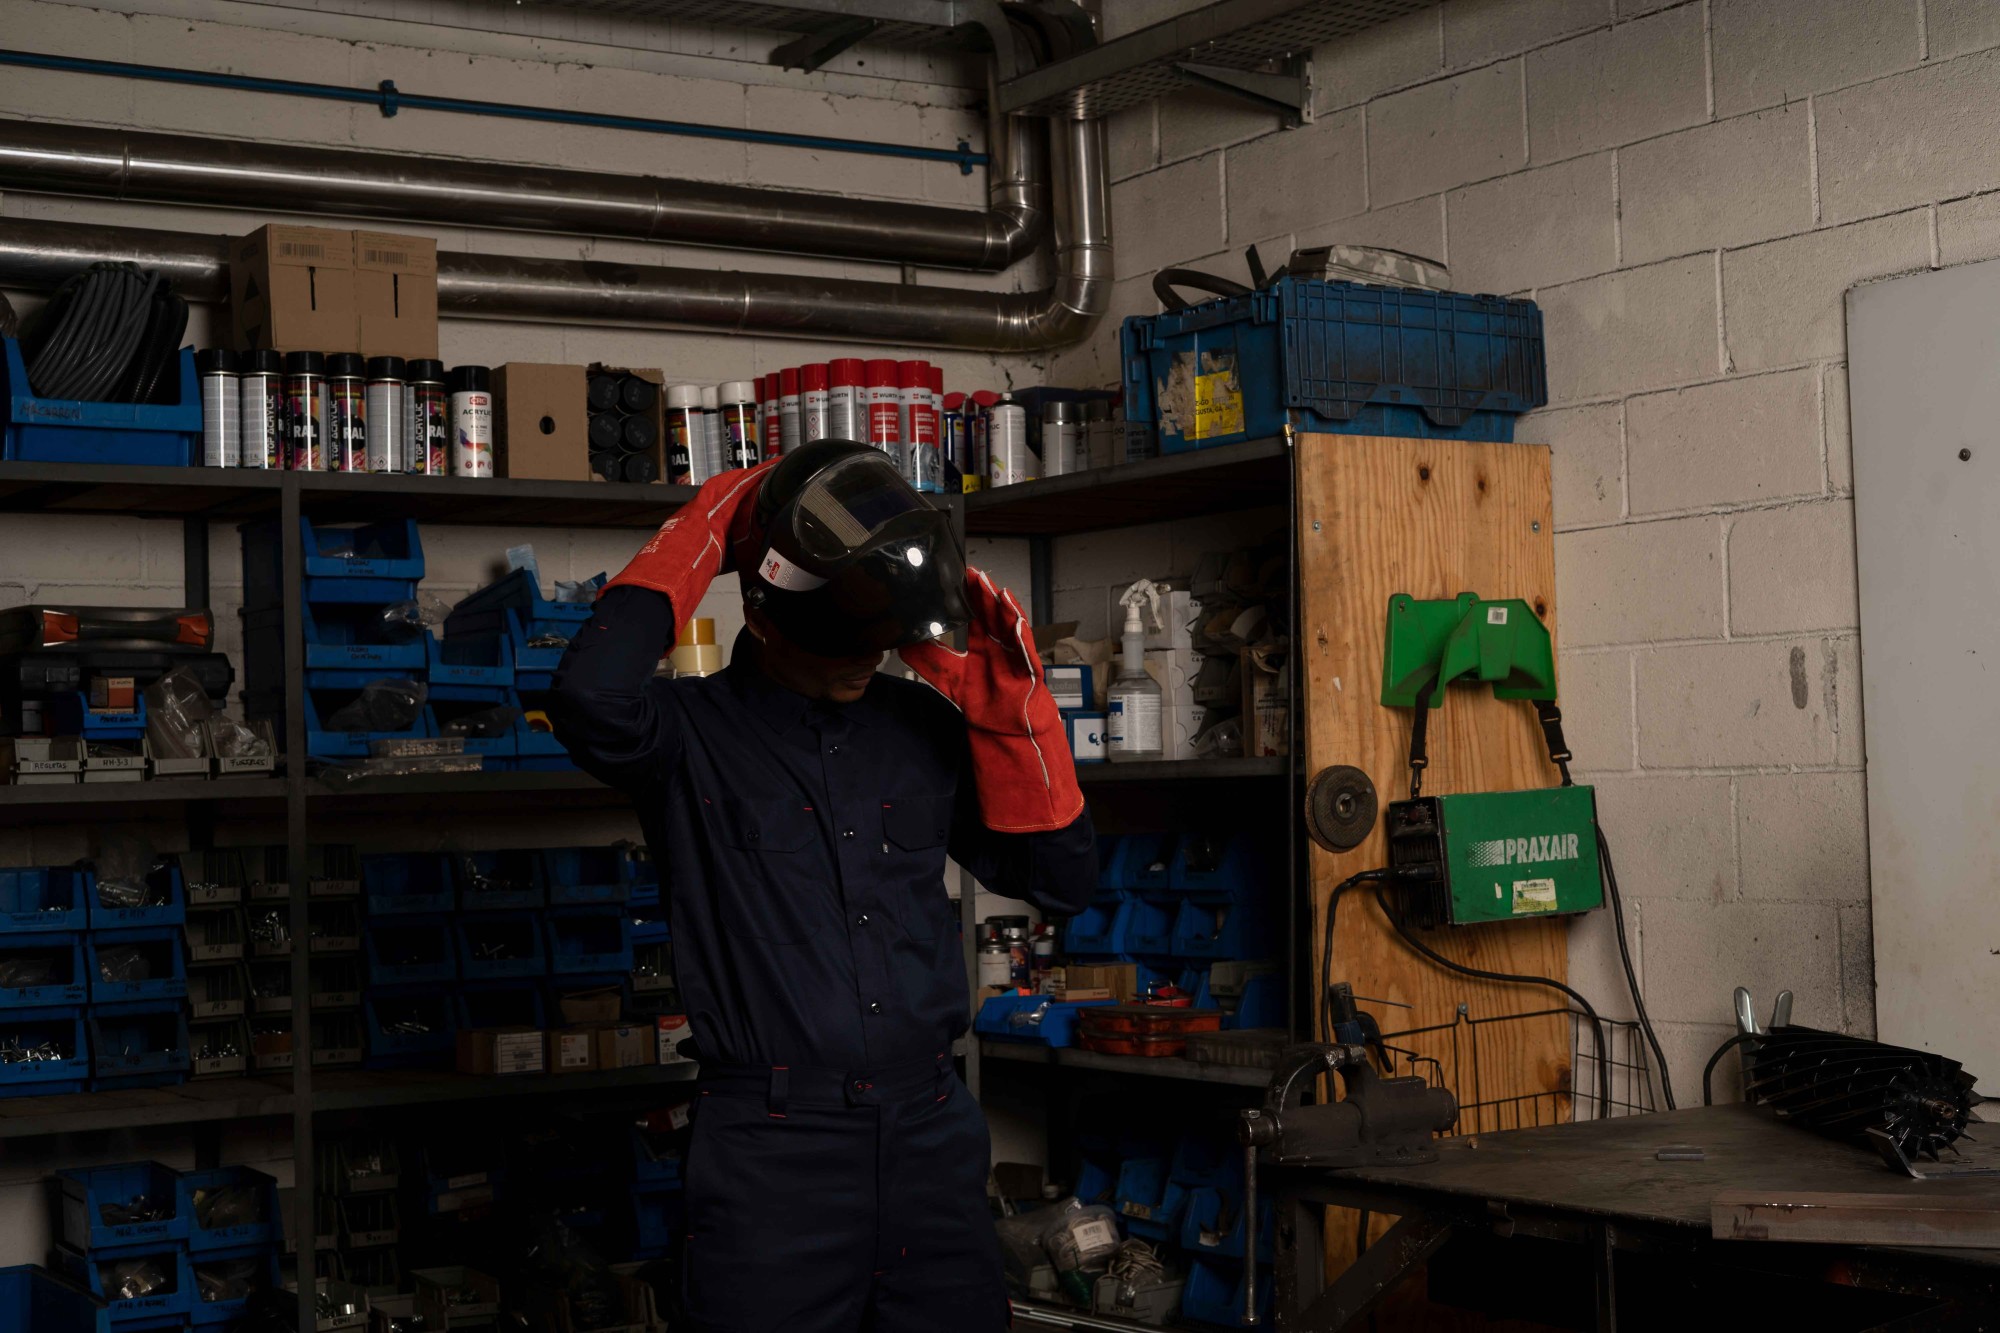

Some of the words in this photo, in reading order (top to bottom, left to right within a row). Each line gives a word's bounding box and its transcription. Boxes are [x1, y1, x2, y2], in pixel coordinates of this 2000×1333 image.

[330, 400, 339, 439] ACRYLIC
[415, 402, 423, 441] ACRYLIC
[293, 425, 317, 438] RAL
[343, 427, 365, 440] RAL
[429, 425, 446, 439] RAL
[415, 441, 423, 461] TOP
[736, 449, 757, 461] RAL
[671, 454, 689, 466] RAL
[1506, 833, 1579, 865] PRAXAIR
